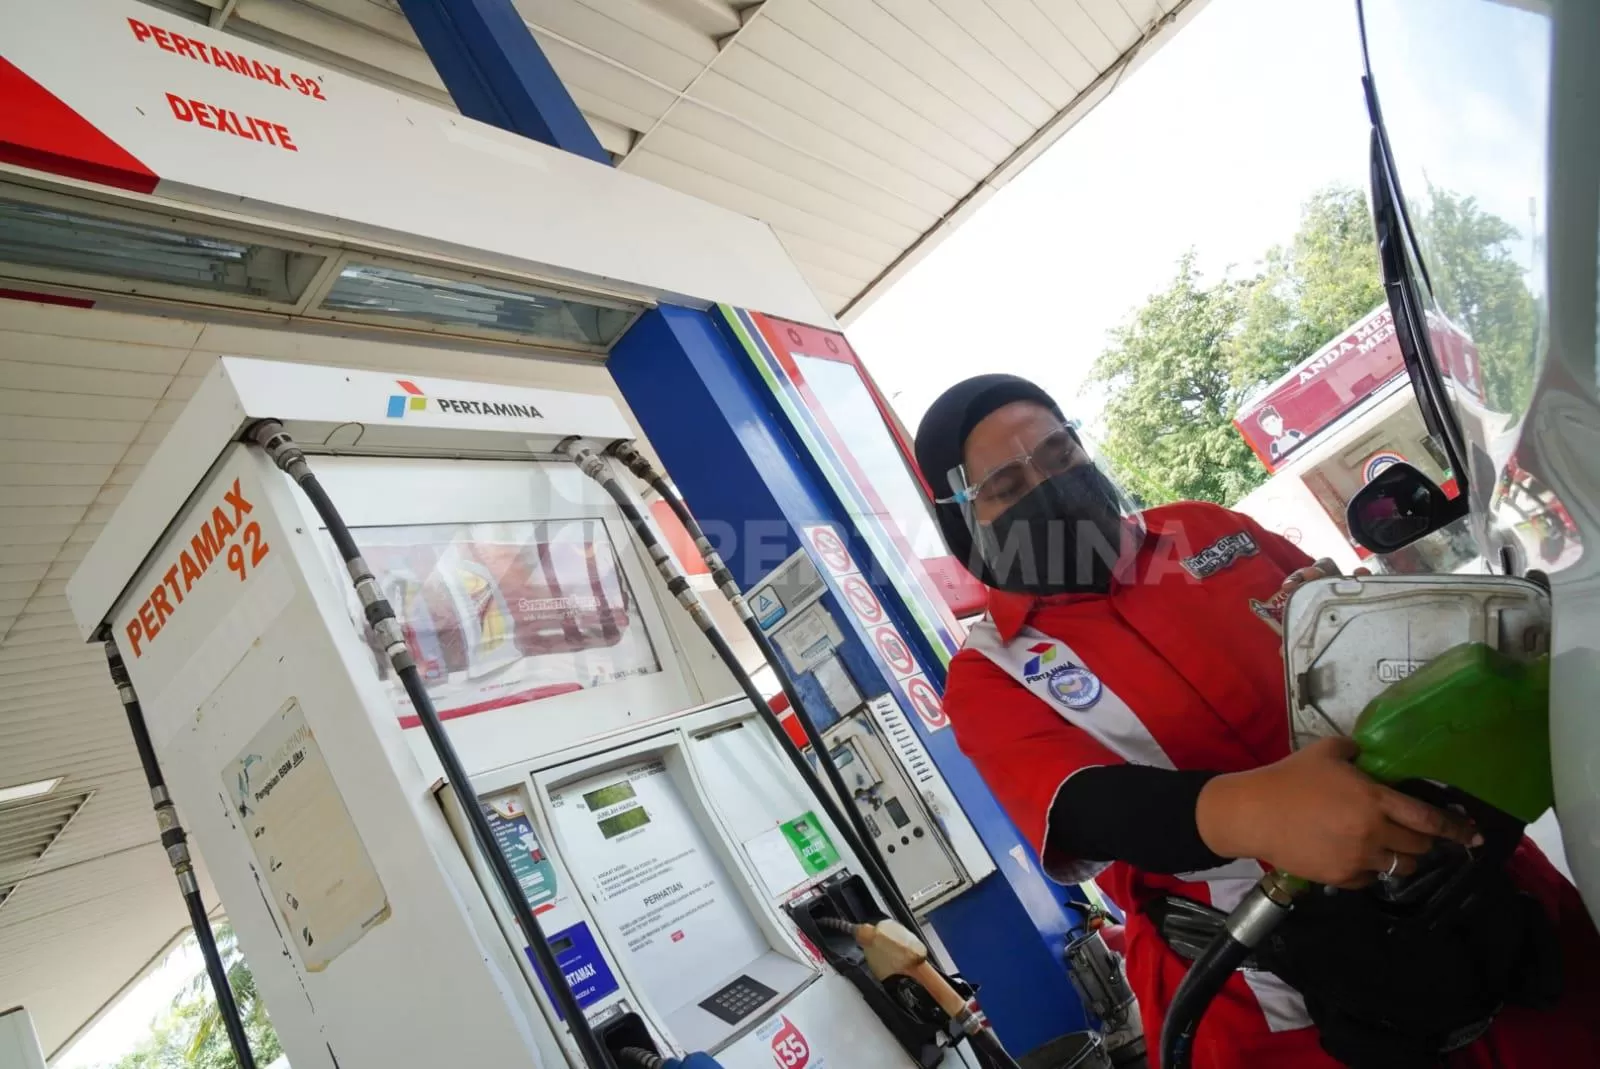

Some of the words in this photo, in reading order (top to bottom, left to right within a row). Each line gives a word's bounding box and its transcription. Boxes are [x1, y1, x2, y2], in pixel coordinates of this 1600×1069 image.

[126, 17, 290, 89] PERTAMAX
[291, 73, 327, 101] 92
[164, 91, 299, 153] DEXLITE
[1299, 341, 1356, 385] ANDA
[438, 398, 544, 420] PERTAMINA
[125, 477, 254, 659] PERTAMAX
[226, 520, 270, 583] 92
[1024, 660, 1076, 685] PERTAMINA
[642, 880, 685, 908] PERHATIAN
[565, 962, 597, 987] RTAMAX
